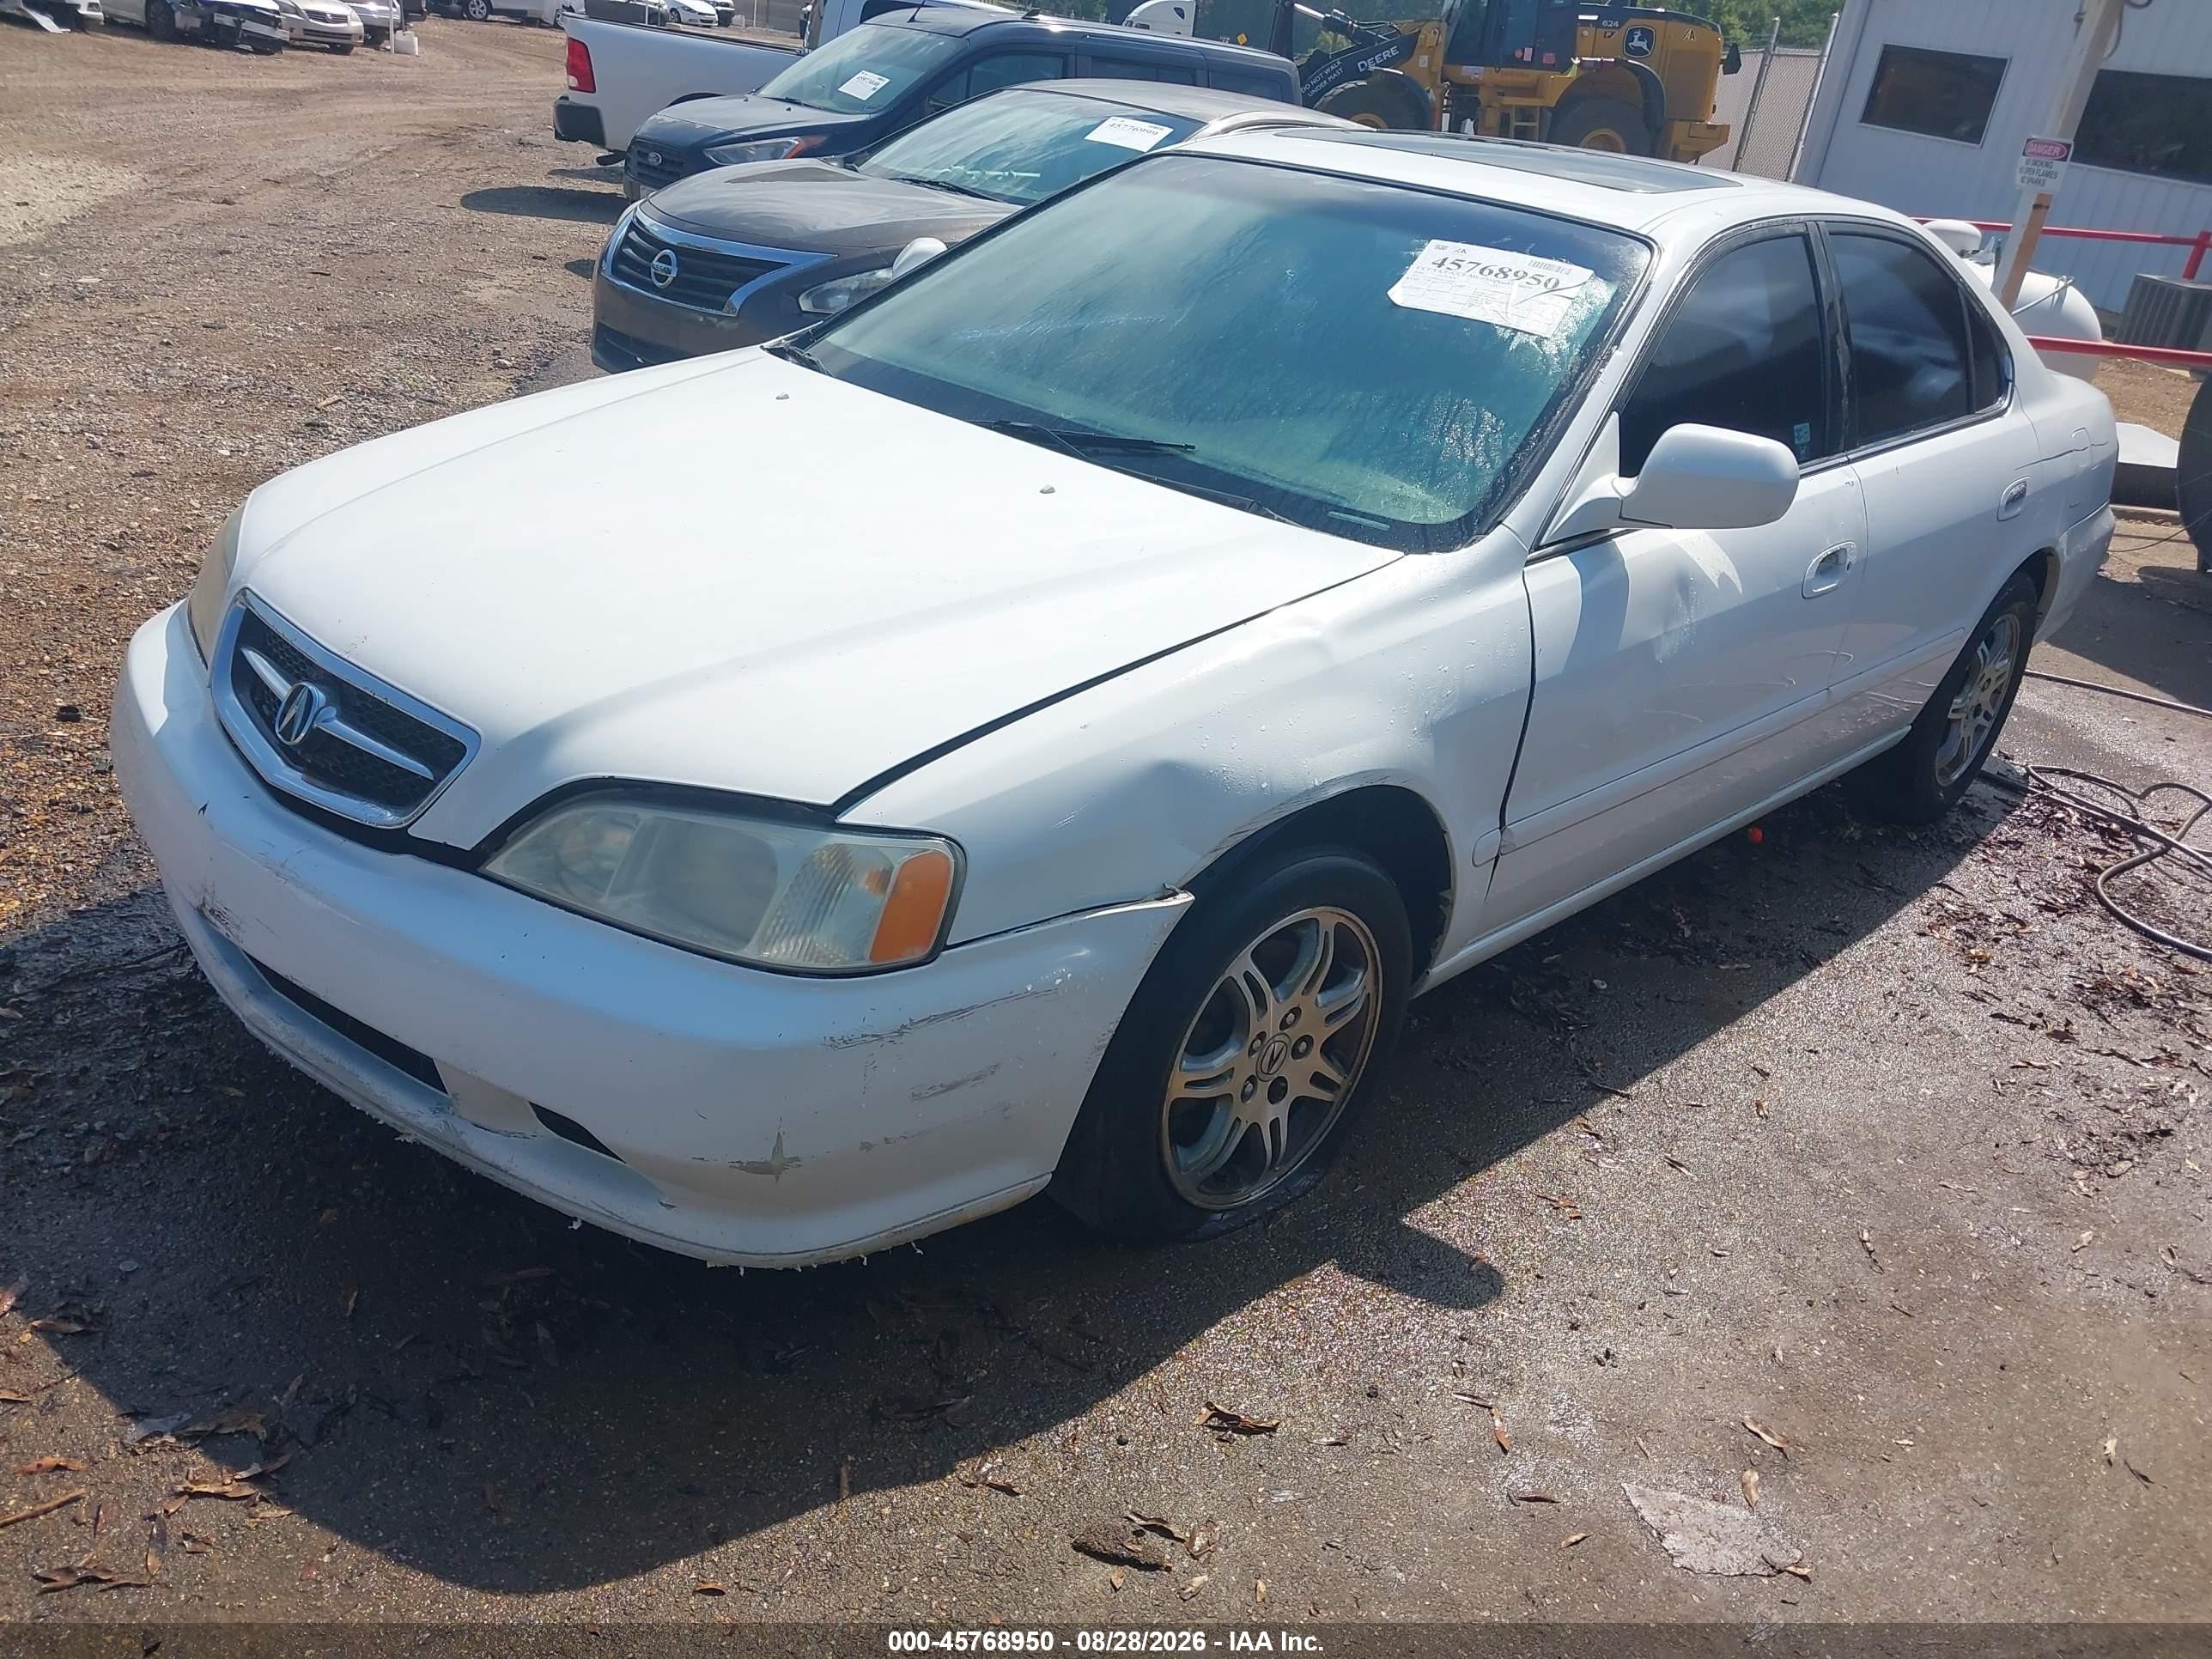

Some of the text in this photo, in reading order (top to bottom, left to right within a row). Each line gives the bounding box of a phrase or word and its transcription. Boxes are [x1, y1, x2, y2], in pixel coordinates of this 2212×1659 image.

[1357, 46, 1400, 73] DEERE
[1300, 60, 1342, 93] DO NOT WALK
[1307, 67, 1344, 97] UNDER MAST
[2027, 143, 2061, 156] DANGER
[2035, 168, 2058, 179] FLAMES
[1431, 257, 1560, 290] 45768950
